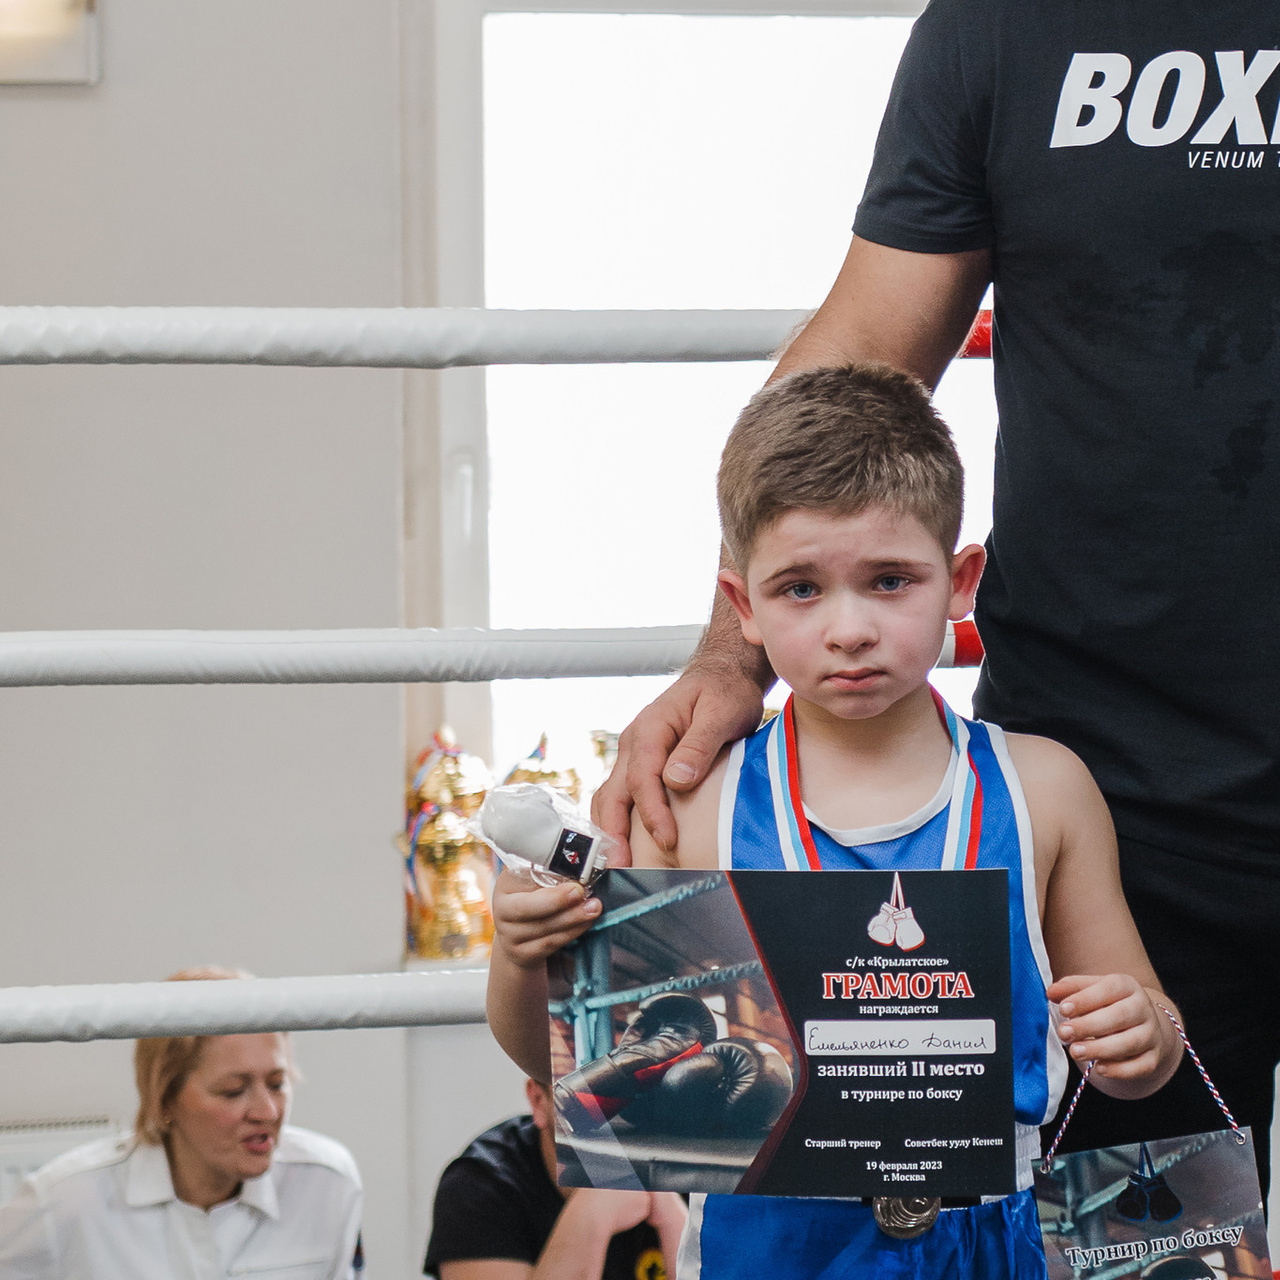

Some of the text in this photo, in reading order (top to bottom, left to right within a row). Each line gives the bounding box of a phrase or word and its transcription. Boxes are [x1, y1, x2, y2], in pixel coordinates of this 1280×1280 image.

[1187, 151, 1265, 169] VENUM
[846, 956, 949, 969] с/к «Крылатское»
[822, 972, 975, 999] ГРАМОТА
[859, 1005, 939, 1016] награждается
[817, 1061, 986, 1077] занявший II место
[841, 1087, 963, 1102] в турнире по боксу
[804, 1138, 882, 1150] Старший тренер
[904, 1137, 1004, 1149] Советбек уулу Кенеш
[865, 1160, 943, 1171] 19 февраля 2023
[883, 1173, 926, 1182] г. Москва
[1065, 1225, 1244, 1268] Турнир по боксу
